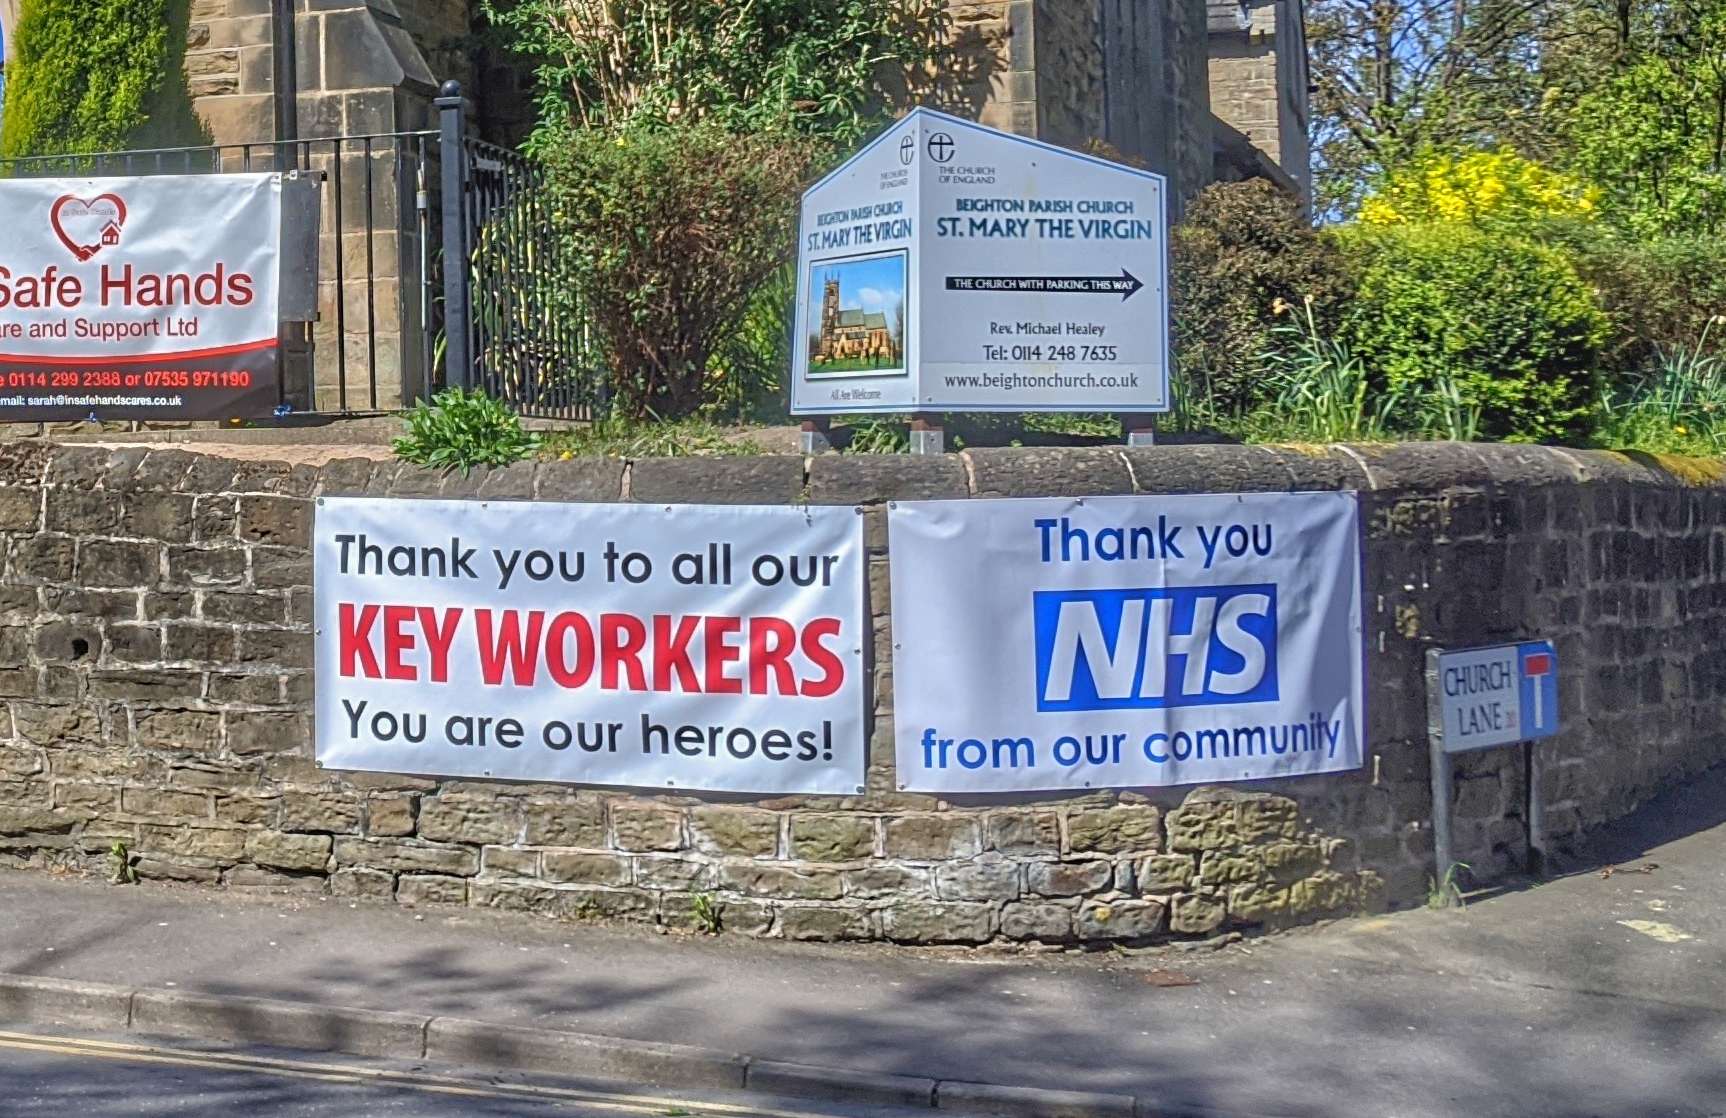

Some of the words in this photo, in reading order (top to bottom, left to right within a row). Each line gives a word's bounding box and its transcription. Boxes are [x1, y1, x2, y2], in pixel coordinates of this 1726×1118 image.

[938, 176, 950, 184] OF
[953, 176, 996, 184] ENGLAND
[940, 166, 956, 175] THE
[957, 166, 996, 176] CHURCH
[817, 209, 849, 226] BEIGHTON
[850, 206, 872, 220] PARISH
[874, 200, 903, 218] CHURCH
[956, 198, 1024, 213] BEIGHTON
[1028, 200, 1073, 214] PARISH
[1077, 200, 1134, 214] CHURCH
[808, 232, 820, 252] ST.
[822, 227, 852, 250] MARY
[853, 224, 873, 245] THE
[874, 218, 912, 242] VIRGIN
[936, 217, 964, 238] ST.
[968, 218, 1030, 238] MARY
[1035, 218, 1074, 238] THE
[1078, 219, 1152, 240] VIRGIN
[101, 262, 254, 306] Hands
[954, 278, 974, 288] THE
[975, 279, 1016, 289] CHURCH
[1018, 280, 1044, 290] WITH
[1046, 280, 1089, 290] PARKING
[1090, 280, 1112, 290] THIS
[1113, 280, 1134, 290] WAY
[29, 318, 66, 338] and
[74, 317, 160, 342] Support
[167, 316, 198, 337] Ltd
[990, 322, 1012, 335] Rev.
[1016, 322, 1062, 335] Michael
[1066, 322, 1106, 337] Healey
[983, 344, 1008, 360] Tel:
[1012, 346, 1042, 361] 0114
[1048, 346, 1076, 361] 248
[1080, 346, 1118, 361] 7635
[8, 372, 46, 387] 0114
[51, 372, 78, 386] 299
[84, 372, 120, 386] 2388
[125, 374, 142, 386] or
[144, 371, 188, 386] 07535
[192, 371, 250, 386] 971190
[944, 372, 1138, 390] www.beightonchurch.co.uk
[28, 394, 182, 406] sarah@insafehandscares.co.uk
[852, 388, 881, 400] Welcome
[1034, 515, 1184, 564] Thank
[1196, 520, 1274, 570] you
[334, 534, 478, 580] Thank
[492, 548, 586, 590] you
[604, 542, 652, 584] to
[670, 543, 732, 586] all
[750, 553, 840, 588] our
[338, 602, 464, 684] KEY
[474, 608, 845, 699] WORKERS
[1043, 592, 1272, 702] NHS
[1444, 660, 1512, 697] CHURCH
[340, 698, 427, 744] You
[444, 714, 524, 750] are
[542, 719, 623, 754] our
[640, 712, 834, 763] heroes!
[1457, 702, 1502, 736] LANE
[921, 727, 1036, 770] from
[1052, 730, 1127, 767] our
[1142, 714, 1342, 764] community
